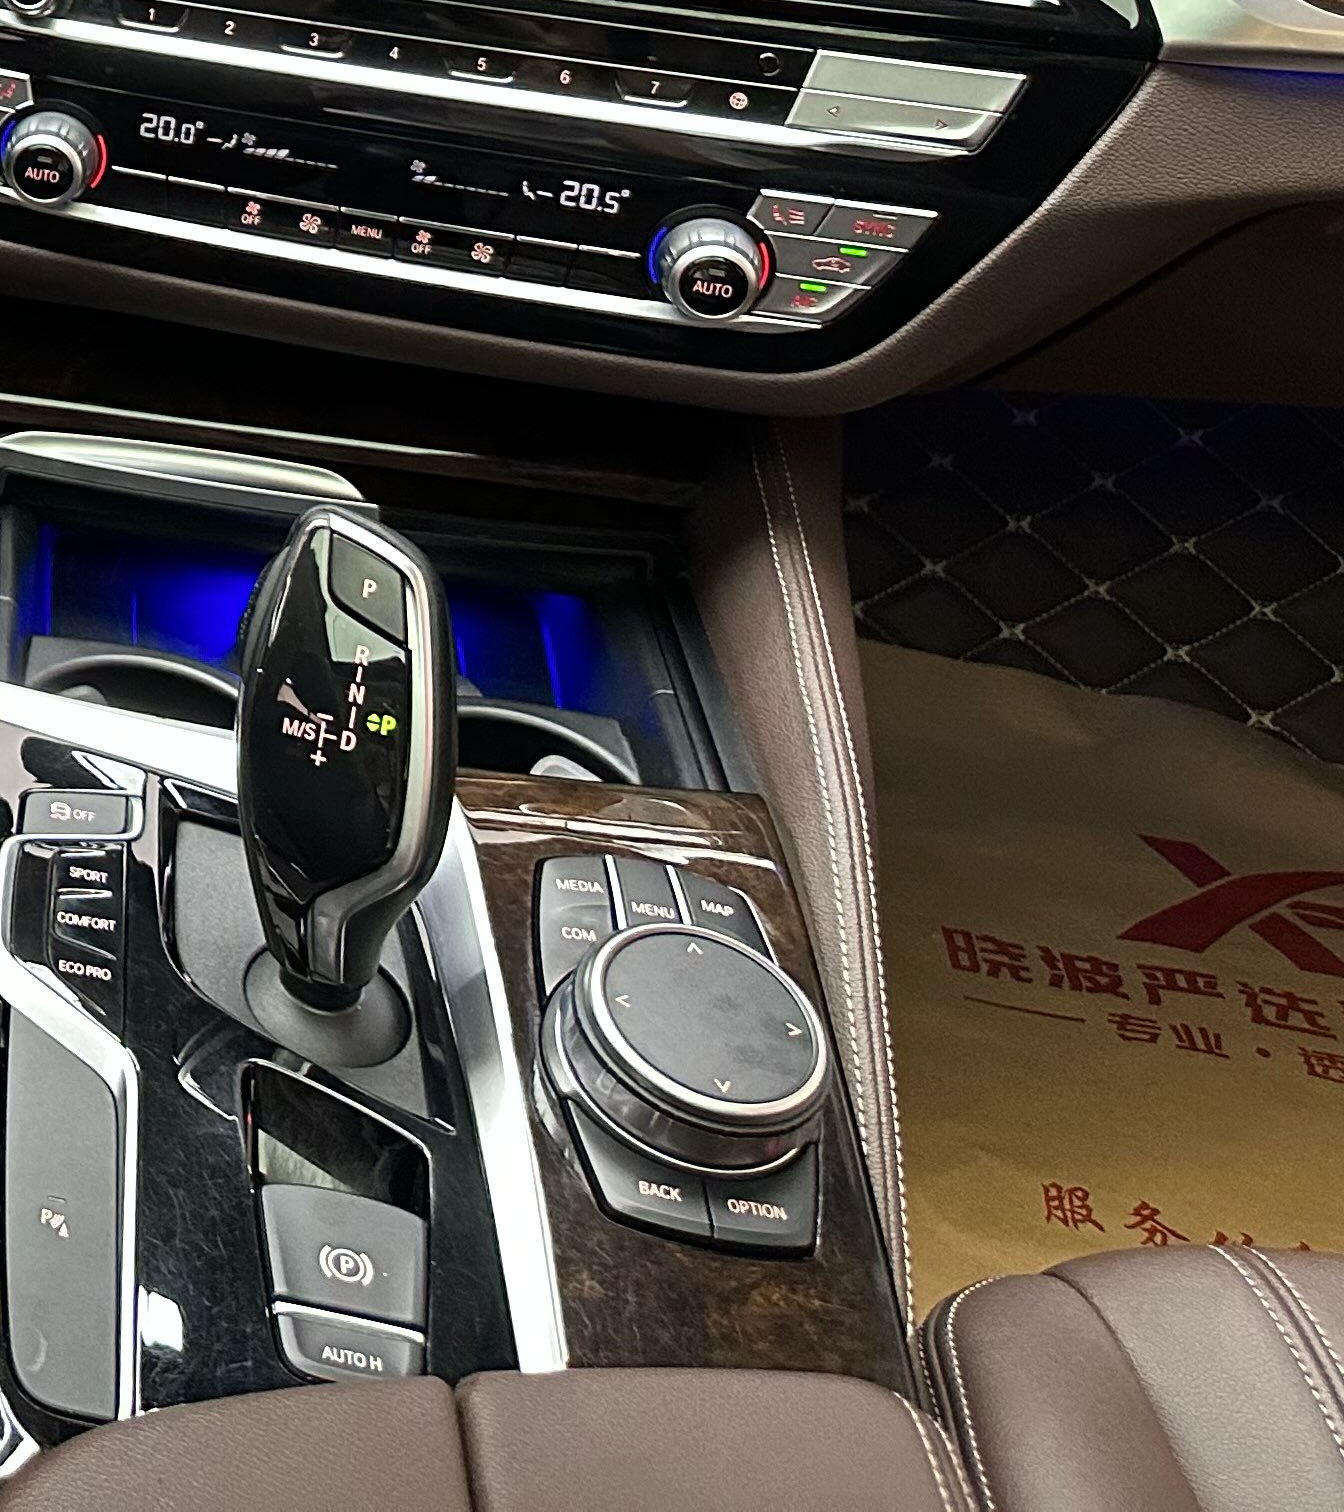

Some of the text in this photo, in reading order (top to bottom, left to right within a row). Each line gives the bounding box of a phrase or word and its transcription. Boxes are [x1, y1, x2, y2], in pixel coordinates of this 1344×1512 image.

[148, 6, 156, 22] 1
[224, 20, 236, 35] 2
[308, 32, 320, 47] 3
[388, 46, 400, 61] 4
[476, 57, 488, 72] 5
[559, 69, 571, 85] 6
[650, 80, 661, 95] 7
[24, 166, 60, 184] AUTO
[240, 214, 262, 227] OFF
[350, 224, 383, 240] MENU
[411, 242, 433, 256] OFF
[692, 280, 733, 299] AUTO
[362, 579, 378, 599] P
[354, 645, 369, 667] R
[348, 683, 366, 705] N
[281, 717, 317, 741] M/S
[380, 714, 397, 736] P
[339, 730, 357, 752] D
[72, 809, 97, 822] OFF
[68, 866, 109, 883] SPORT
[555, 878, 605, 894] MEDIA
[631, 901, 675, 920] MENU
[700, 899, 735, 917] MAP
[56, 911, 117, 932] COMFORT
[561, 926, 597, 942] COM
[58, 960, 112, 981] ECO PRO
[638, 1180, 683, 1202] BACK
[727, 1198, 788, 1221] OPTION
[321, 1345, 384, 1372] AUTO H
